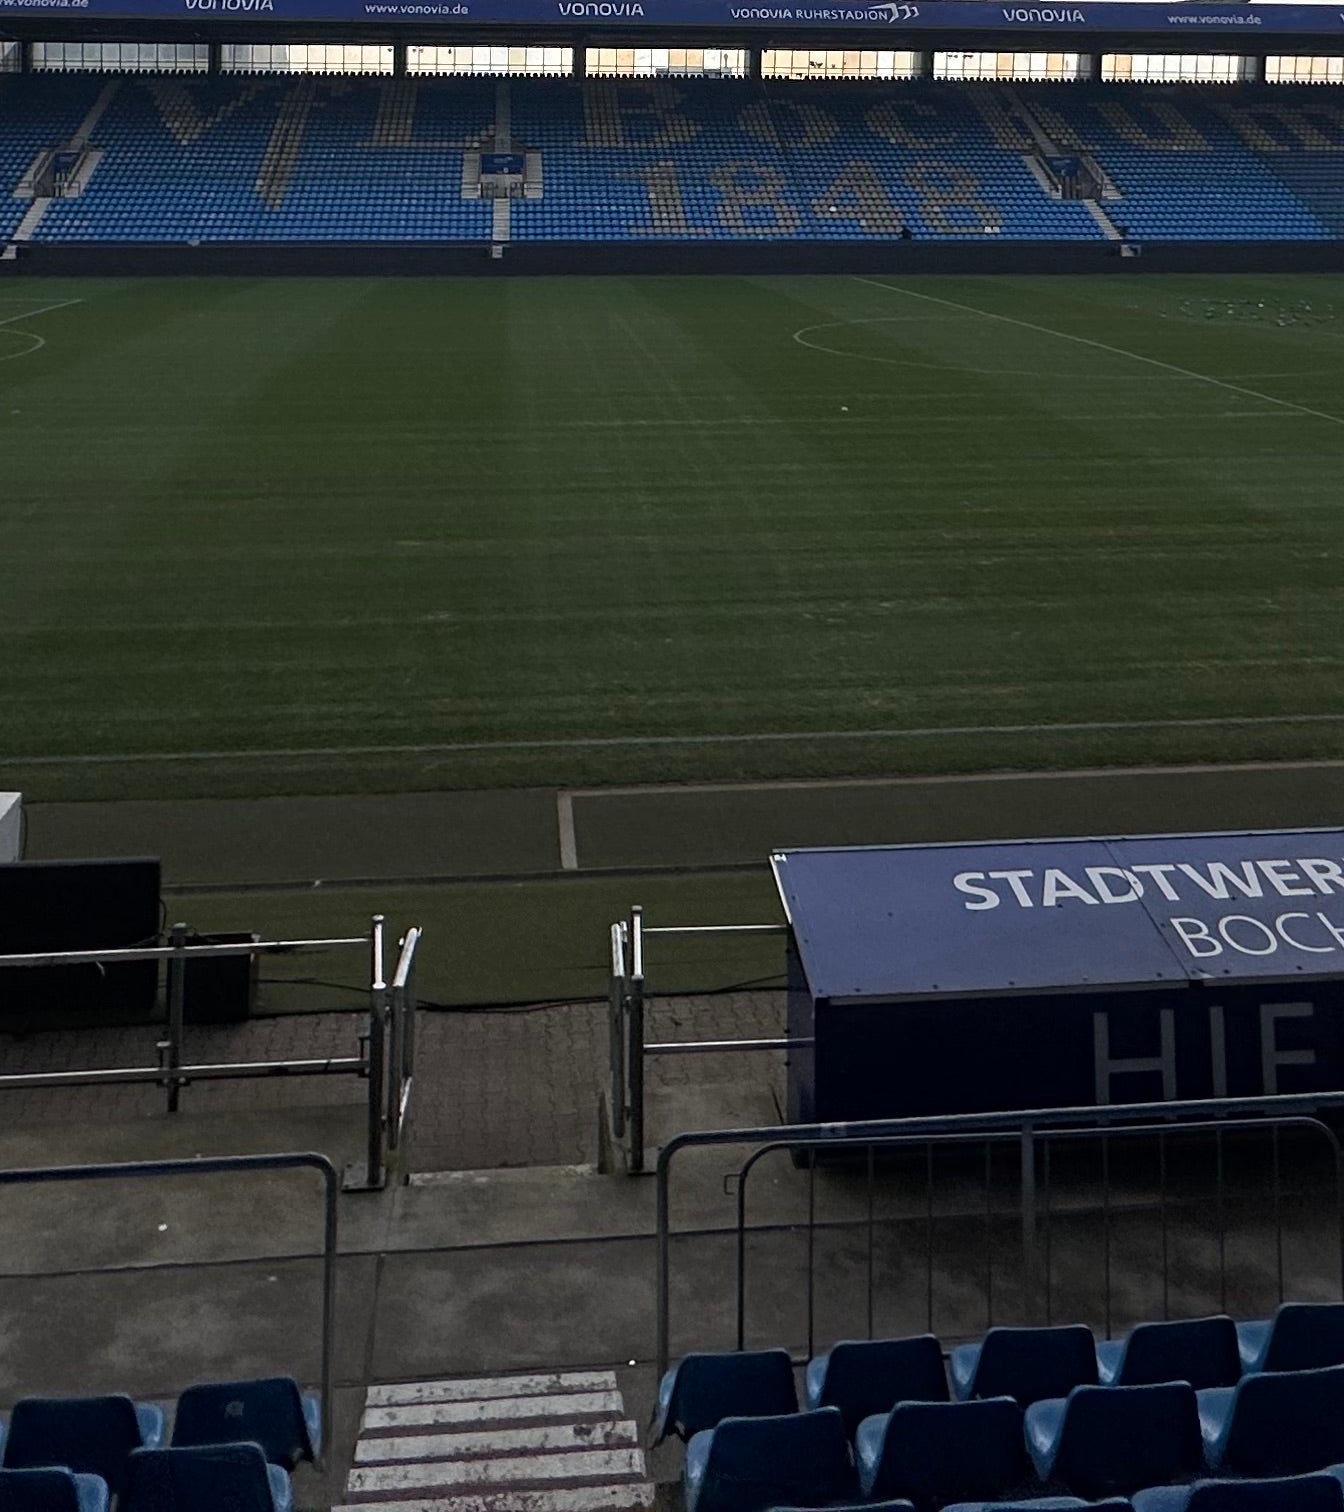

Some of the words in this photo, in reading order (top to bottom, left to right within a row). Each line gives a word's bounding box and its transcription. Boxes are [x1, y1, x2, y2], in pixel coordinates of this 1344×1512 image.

[364, 2, 469, 15] www.vonovia.de
[796, 9, 889, 21] RUHRSTADION
[1167, 13, 1262, 25] www.vonovia.de
[614, 158, 1004, 235] 1848
